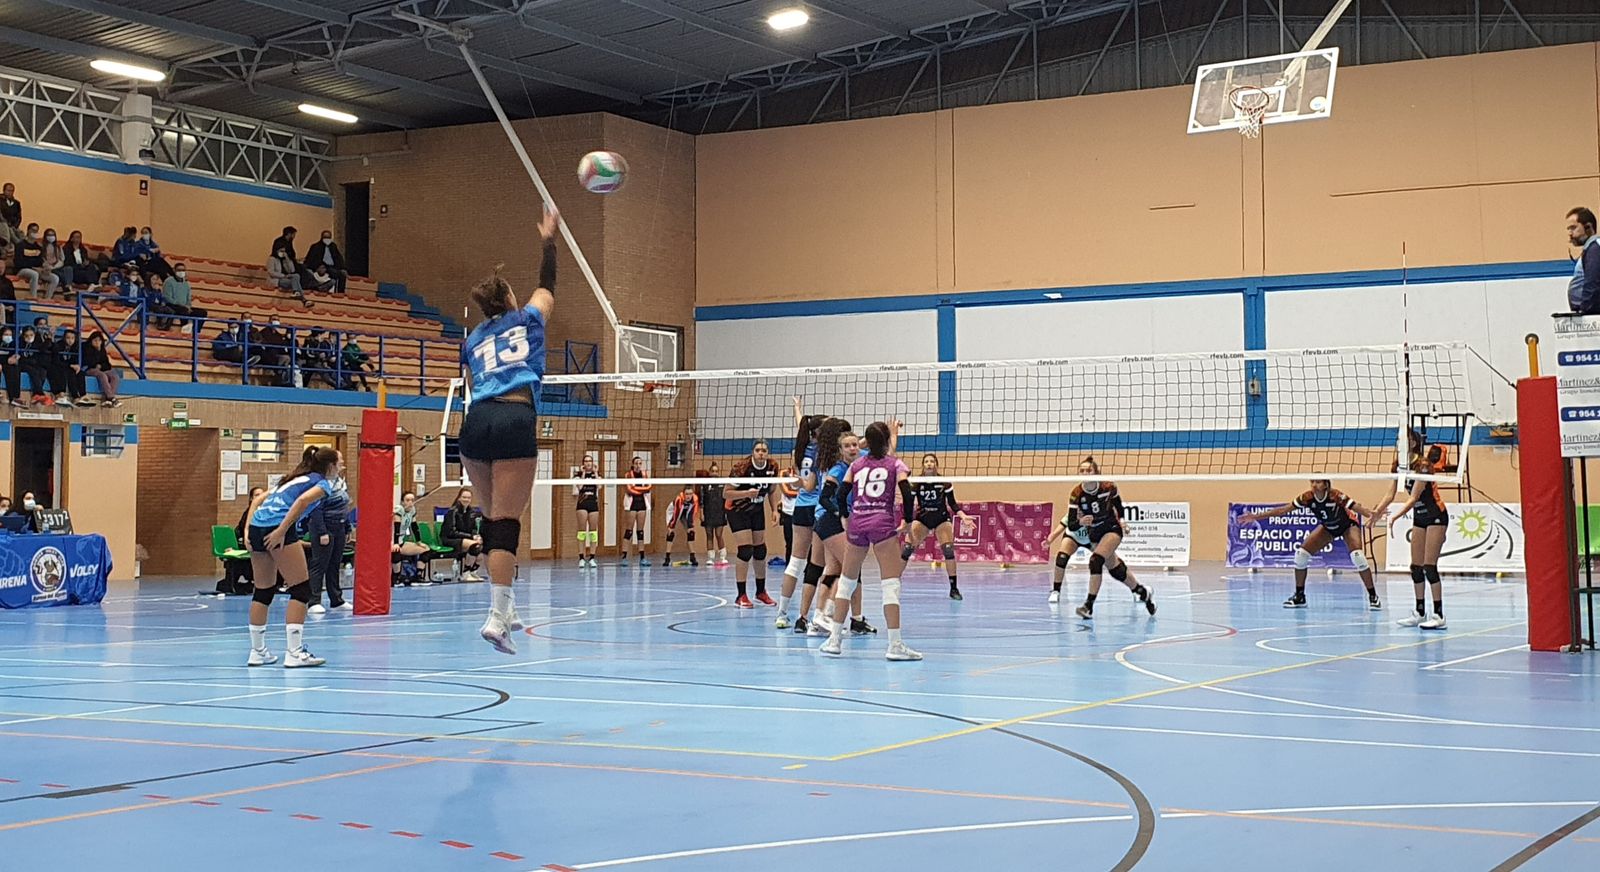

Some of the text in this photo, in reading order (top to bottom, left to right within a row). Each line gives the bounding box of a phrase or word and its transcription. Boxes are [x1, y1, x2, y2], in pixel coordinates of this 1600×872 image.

[472, 325, 530, 372] 13
[1302, 348, 1339, 356] rfevb.com
[1575, 354, 1592, 362] 954
[1579, 410, 1595, 418] 954
[853, 466, 888, 498] 18
[924, 490, 937, 501] 23
[1091, 501, 1100, 513] 8
[1320, 510, 1328, 519] 3
[1268, 516, 1318, 525] PROYECTO
[1239, 529, 1292, 540] ESPACIO
[70, 563, 99, 578] VOLEY
